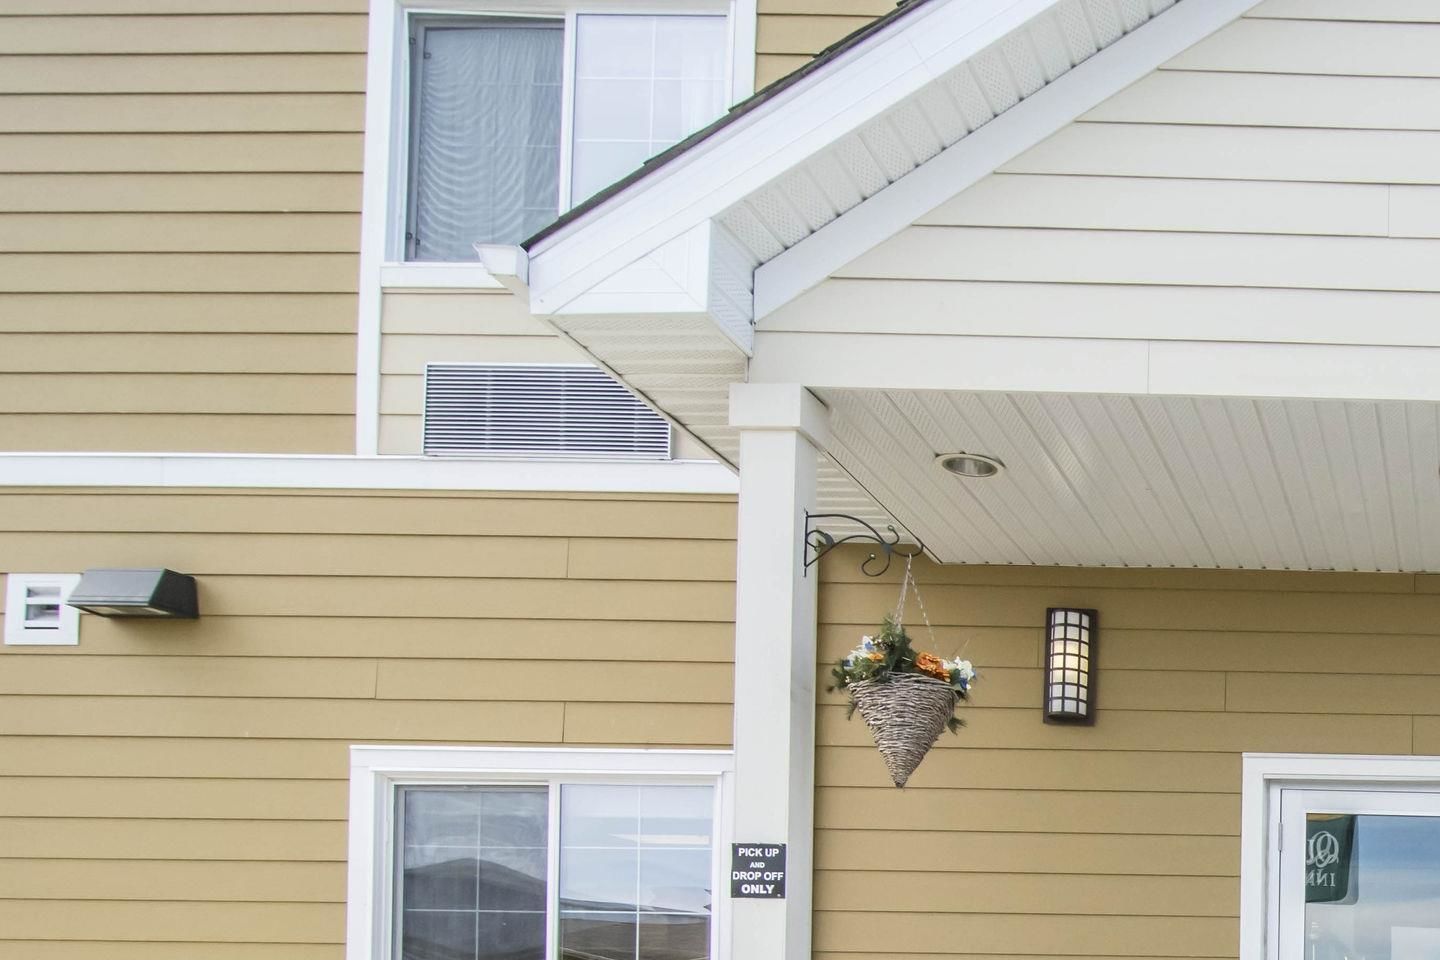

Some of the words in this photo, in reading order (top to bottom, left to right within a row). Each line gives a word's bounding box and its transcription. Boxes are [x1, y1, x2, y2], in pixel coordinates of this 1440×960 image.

[738, 848, 763, 857] PICK
[765, 848, 779, 857] UP
[732, 871, 762, 880] DROP
[763, 872, 784, 880] OFF
[741, 884, 775, 894] ONLY
